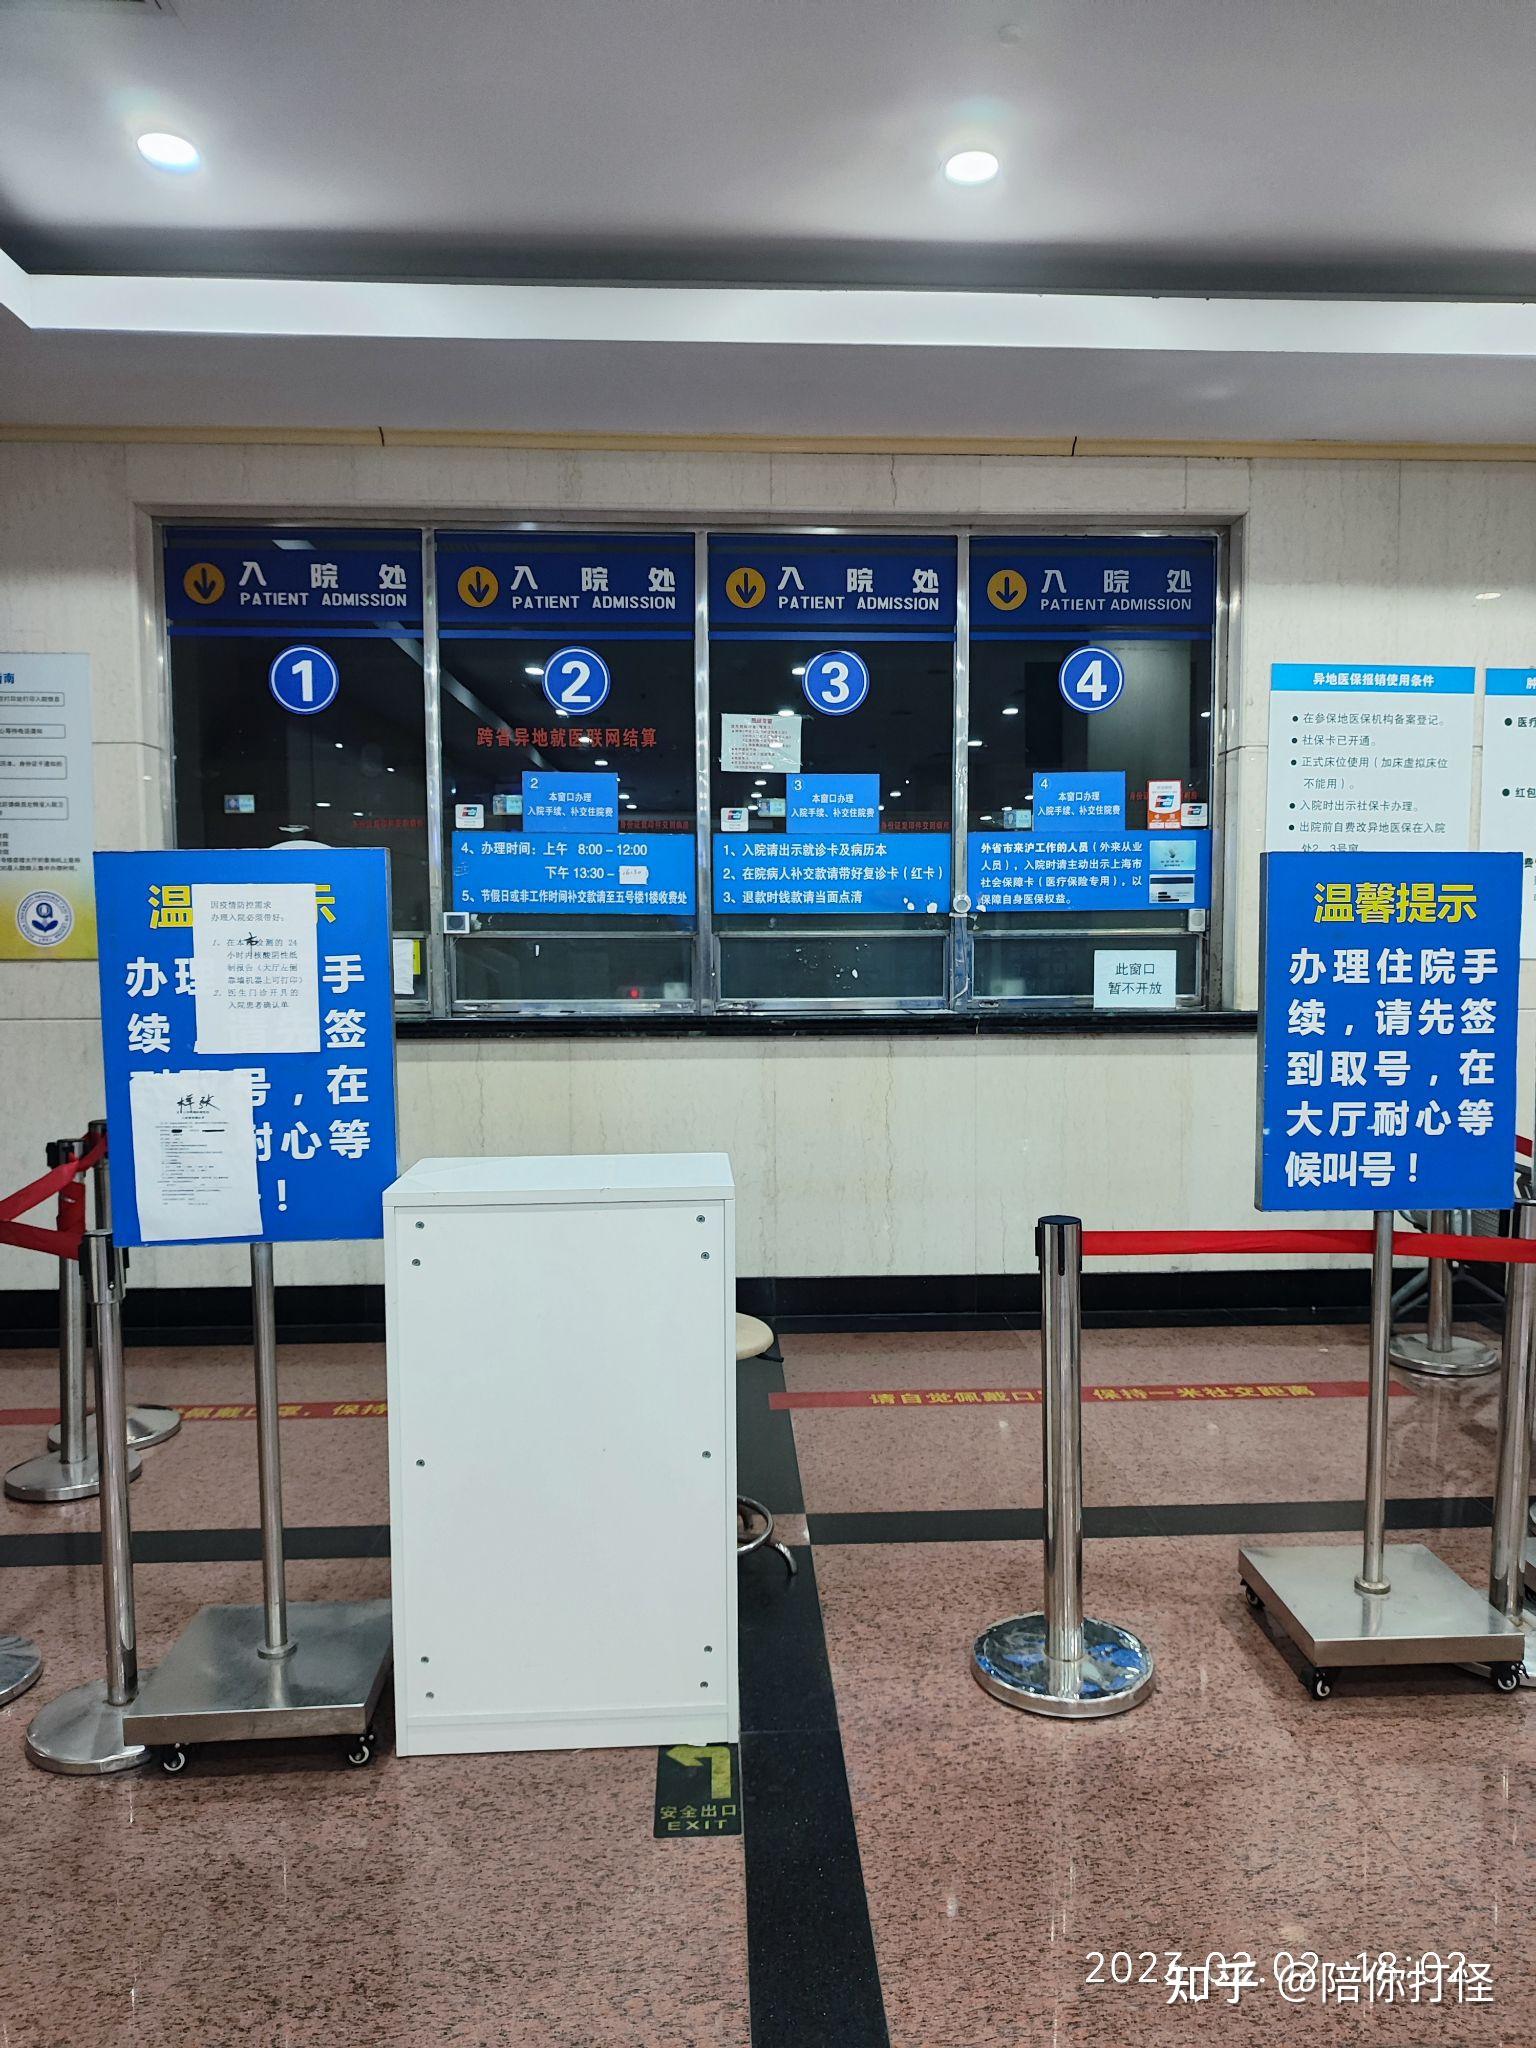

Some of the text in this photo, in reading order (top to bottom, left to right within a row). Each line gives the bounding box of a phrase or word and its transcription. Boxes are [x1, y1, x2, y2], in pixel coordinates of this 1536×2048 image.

[239, 562, 406, 590] 入院处
[511, 566, 675, 592] 入院处
[777, 567, 939, 593] 入院处
[1041, 570, 1191, 593] 入院处
[240, 592, 406, 607] PATIENT ADMISSION
[512, 596, 675, 609] PATIENT ADMISSION
[778, 596, 939, 610] PATIENT ADMISSION
[1041, 599, 1191, 611] PATIENT ADMISSION
[292, 660, 313, 702] 1
[561, 661, 591, 702] 2
[821, 661, 850, 703] 3
[1076, 660, 1107, 701] 4
[1313, 672, 1434, 688] 异地医保报销使用条件
[1303, 713, 1444, 726] 在参保地医保机构备案登记。
[477, 728, 656, 748] 跨省异地就医联网结算
[1302, 735, 1376, 747] 社保卡已开通。
[530, 777, 539, 789] 2
[549, 792, 592, 803] 本窗口办理
[812, 793, 854, 804] 本窗口办理
[1058, 791, 1100, 802] 本窗口办理
[527, 806, 613, 818] 入院手续、补交住院费
[791, 807, 874, 818] 入院手续、补交住院费
[1037, 805, 1121, 817] 入院手续、补交住院费
[1300, 800, 1419, 812] 入院时出示社保卡办理。
[1299, 821, 1446, 834] 出院前自费改异地医保在入院
[723, 843, 887, 857] 1、入院请出示就诊卡及病历本
[981, 841, 1142, 854] 外省市来沪工作的人员（外来从业
[981, 859, 1142, 871] 人员），入院时请主动出示上海市
[544, 866, 569, 880] 下午
[723, 866, 943, 881] 2、在院病人补交款请带好复诊卡（红卡）
[461, 889, 687, 905] 5、节假日或非工作时间补交款请至五号楼1楼收费处
[723, 890, 862, 905] 3、退款时钱款请当面点清
[980, 894, 1072, 906] 保障自身医保权益。
[1313, 882, 1477, 924] 温馨提示
[1115, 962, 1155, 976] 此窗口
[1288, 948, 1499, 985] 办理住院手
[1108, 981, 1162, 995] 暂不开放
[1287, 998, 1497, 1036] 续，请先签
[1286, 1048, 1496, 1087] 到取号，在
[1285, 1099, 1495, 1137] 大厅耐心等
[1284, 1151, 1418, 1188] 候叫号！
[869, 1391, 1042, 1405] 请自觉佩戴口
[660, 1804, 736, 1819] 安全出口
[667, 1820, 728, 1830] EXIT
